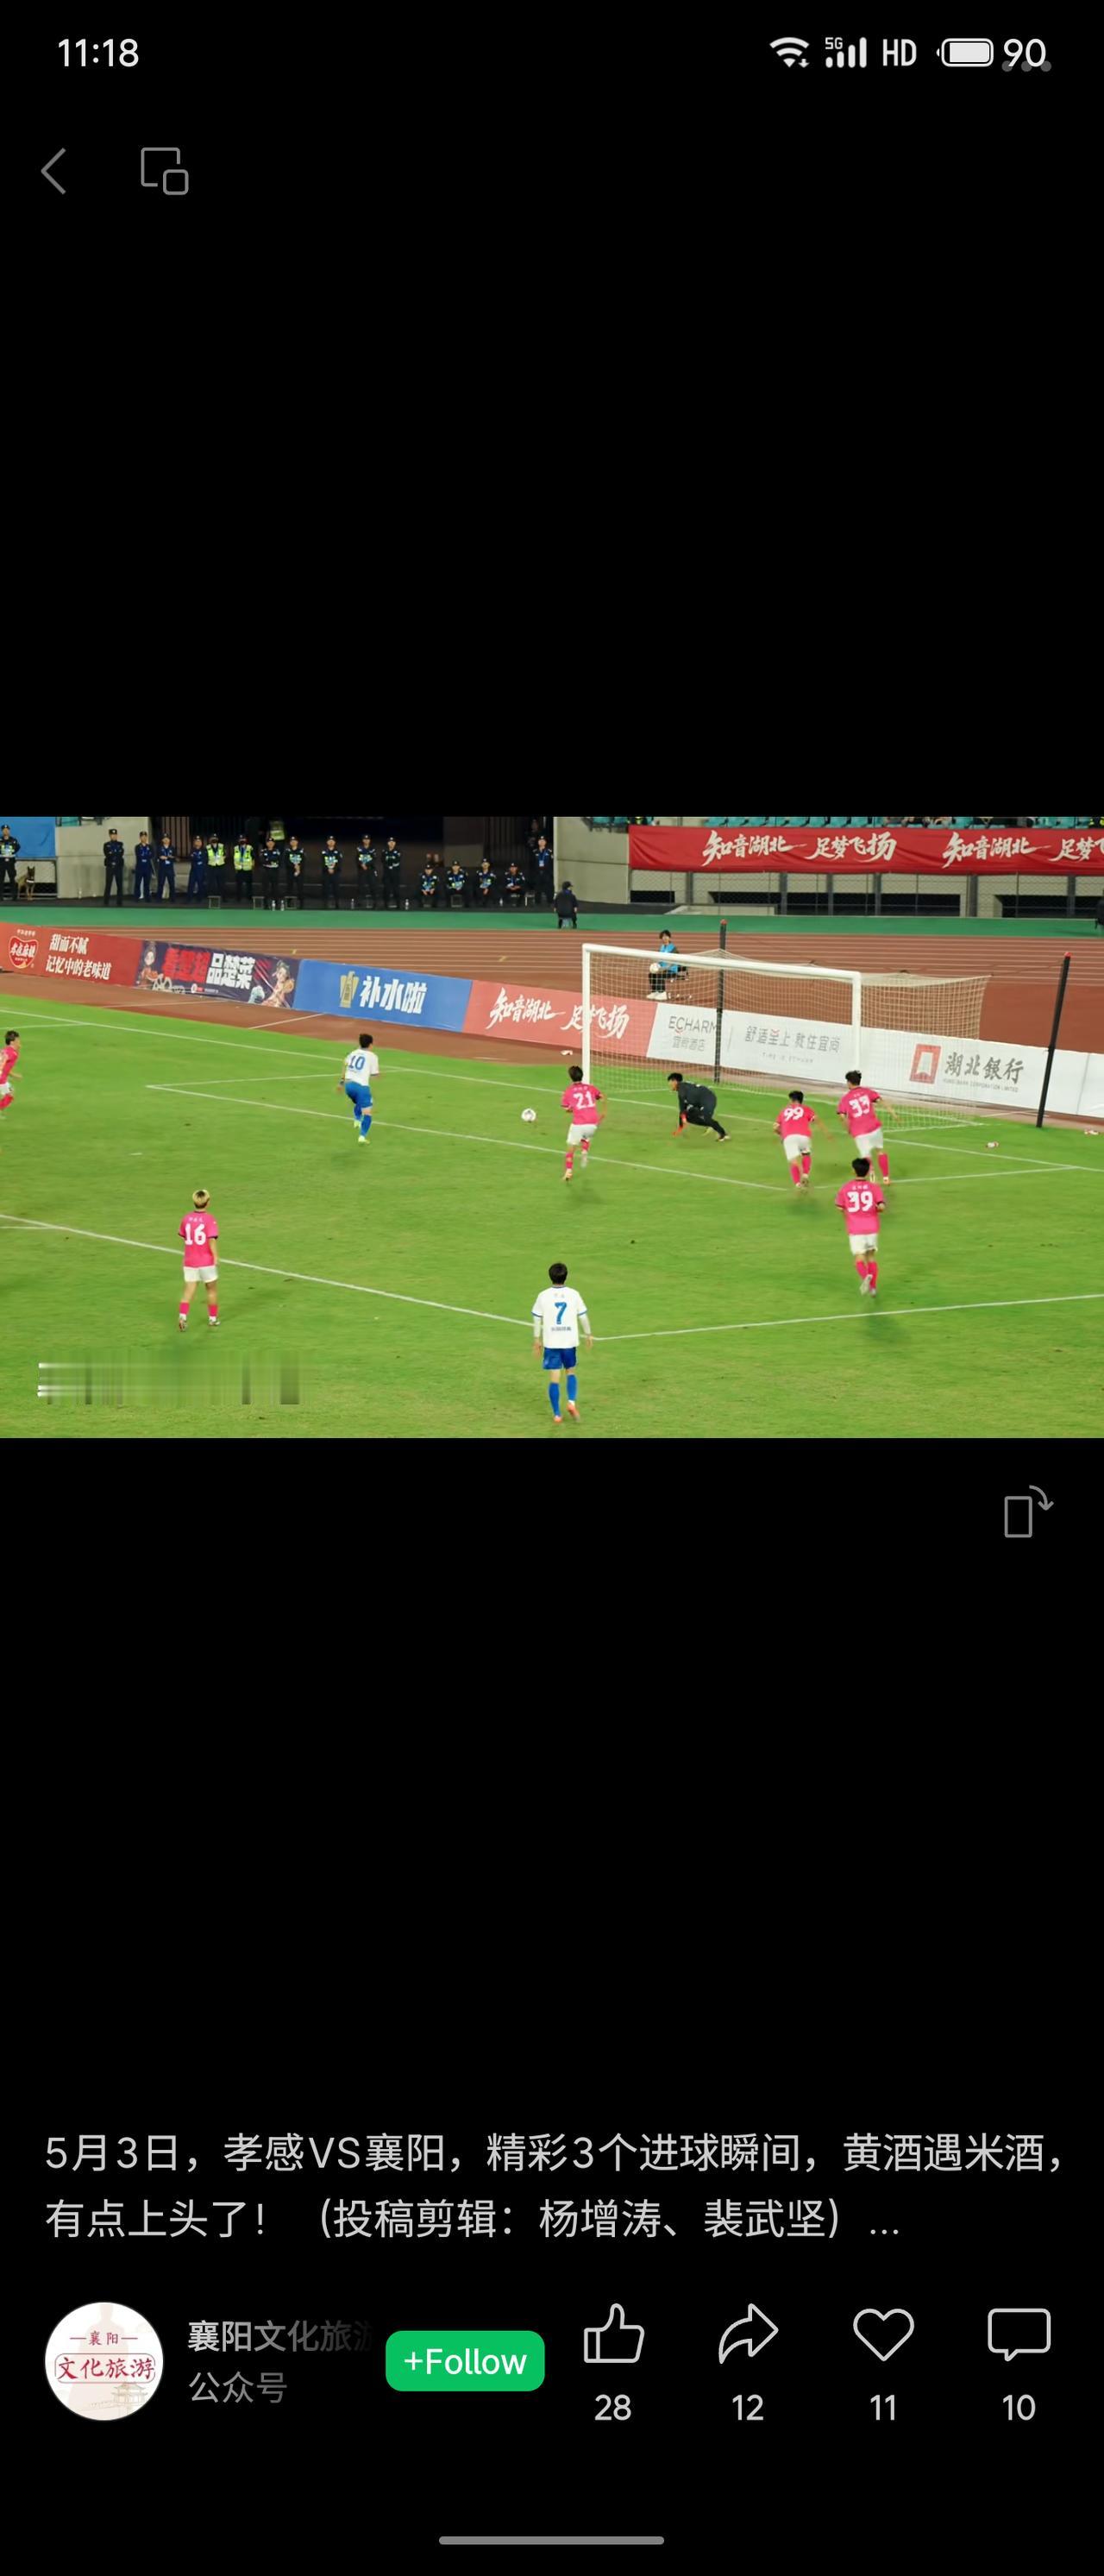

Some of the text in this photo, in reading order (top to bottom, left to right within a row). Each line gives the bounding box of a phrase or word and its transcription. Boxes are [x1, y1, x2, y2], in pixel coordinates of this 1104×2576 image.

[58, 38, 139, 67] 11:18
[825, 36, 844, 50] 5G
[882, 38, 917, 66] HD
[1003, 38, 1046, 67] 90
[700, 830, 897, 867] 知音湖北 足梦飞扬
[942, 832, 1051, 869] 知音湖北
[46, 955, 112, 981] 记忆中的老味道
[359, 975, 428, 1015] 补水啦
[486, 987, 630, 1040] 知音湖北 足飞扬
[348, 1055, 366, 1071] 10
[573, 1090, 596, 1110] 21
[849, 1095, 870, 1118] 33
[784, 1106, 804, 1122] 99
[847, 1191, 874, 1212] 39
[185, 1223, 207, 1246] 16
[555, 1302, 568, 1325] 7
[88, 2330, 120, 2346] 襄阳
[56, 2357, 156, 2380] 文化旅游
[404, 2347, 528, 2375] +Follow
[188, 2371, 287, 2403] 公众号
[594, 2394, 632, 2421] 28
[732, 2394, 764, 2421] 12
[870, 2394, 895, 2421] 11
[1002, 2394, 1036, 2421] 10
